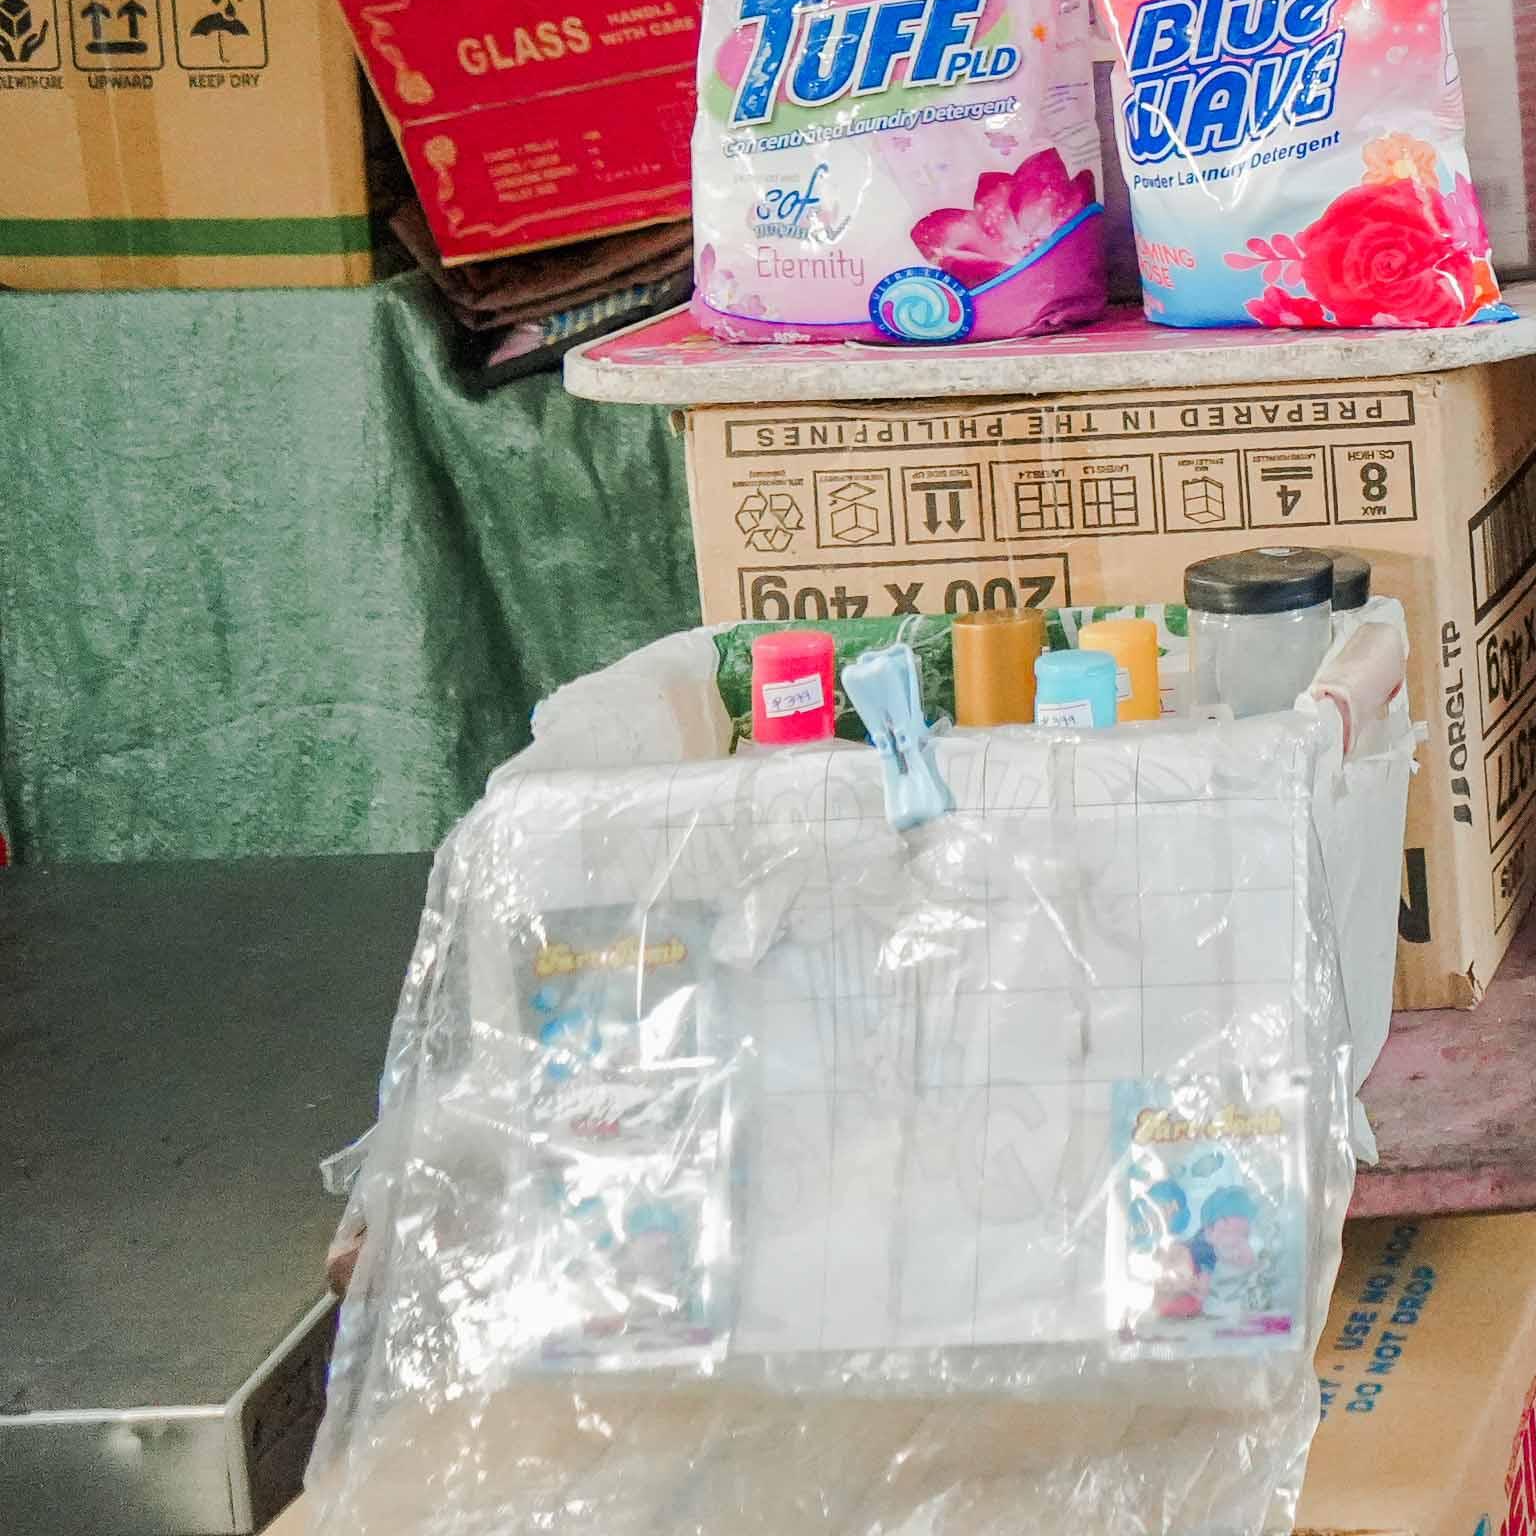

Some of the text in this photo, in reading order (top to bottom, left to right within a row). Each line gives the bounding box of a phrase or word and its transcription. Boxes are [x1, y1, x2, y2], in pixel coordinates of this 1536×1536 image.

[456, 15, 592, 76] GLASS
[942, 46, 1023, 88] PLD
[188, 73, 261, 90] KEEP DRY
[1121, 27, 1347, 164] WAVE
[722, 96, 1017, 157] Concentrated Laundry Detergent
[1132, 129, 1341, 191] Powder Laundry Detergent
[755, 246, 867, 286] Eternity
[755, 398, 1383, 450] PREPARED IN THE PHILIPPINES
[1276, 483, 1302, 518] 4
[1359, 463, 1388, 504] 8
[1361, 505, 1387, 517] MAX
[1368, 1330, 1409, 1375] NOT
